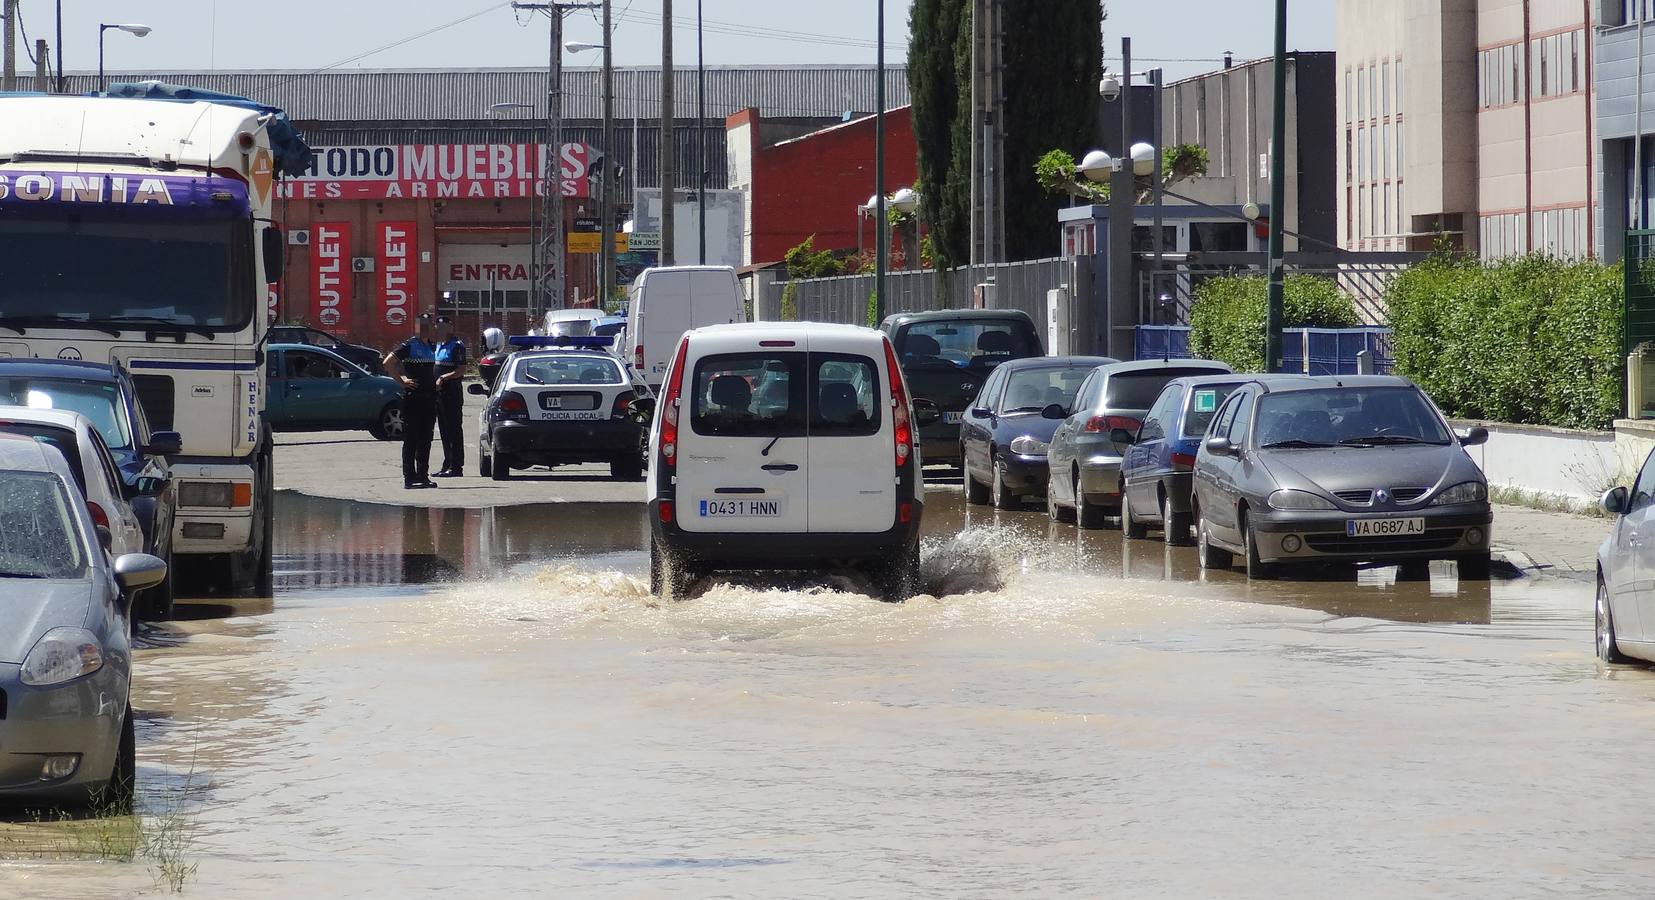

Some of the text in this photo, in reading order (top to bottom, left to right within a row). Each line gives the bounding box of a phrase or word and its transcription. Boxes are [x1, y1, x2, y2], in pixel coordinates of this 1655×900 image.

[310, 147, 394, 177] TODO
[385, 181, 577, 198] ARMARIOS
[319, 226, 341, 325] OUTLET
[385, 226, 407, 325] OUTLET
[547, 397, 559, 407] VA
[248, 381, 256, 442] HENAR
[541, 412, 598, 420] POLICIA LOCAL
[709, 501, 777, 515] 0431 HNN
[1355, 519, 1423, 534] VA 0687 AJ
